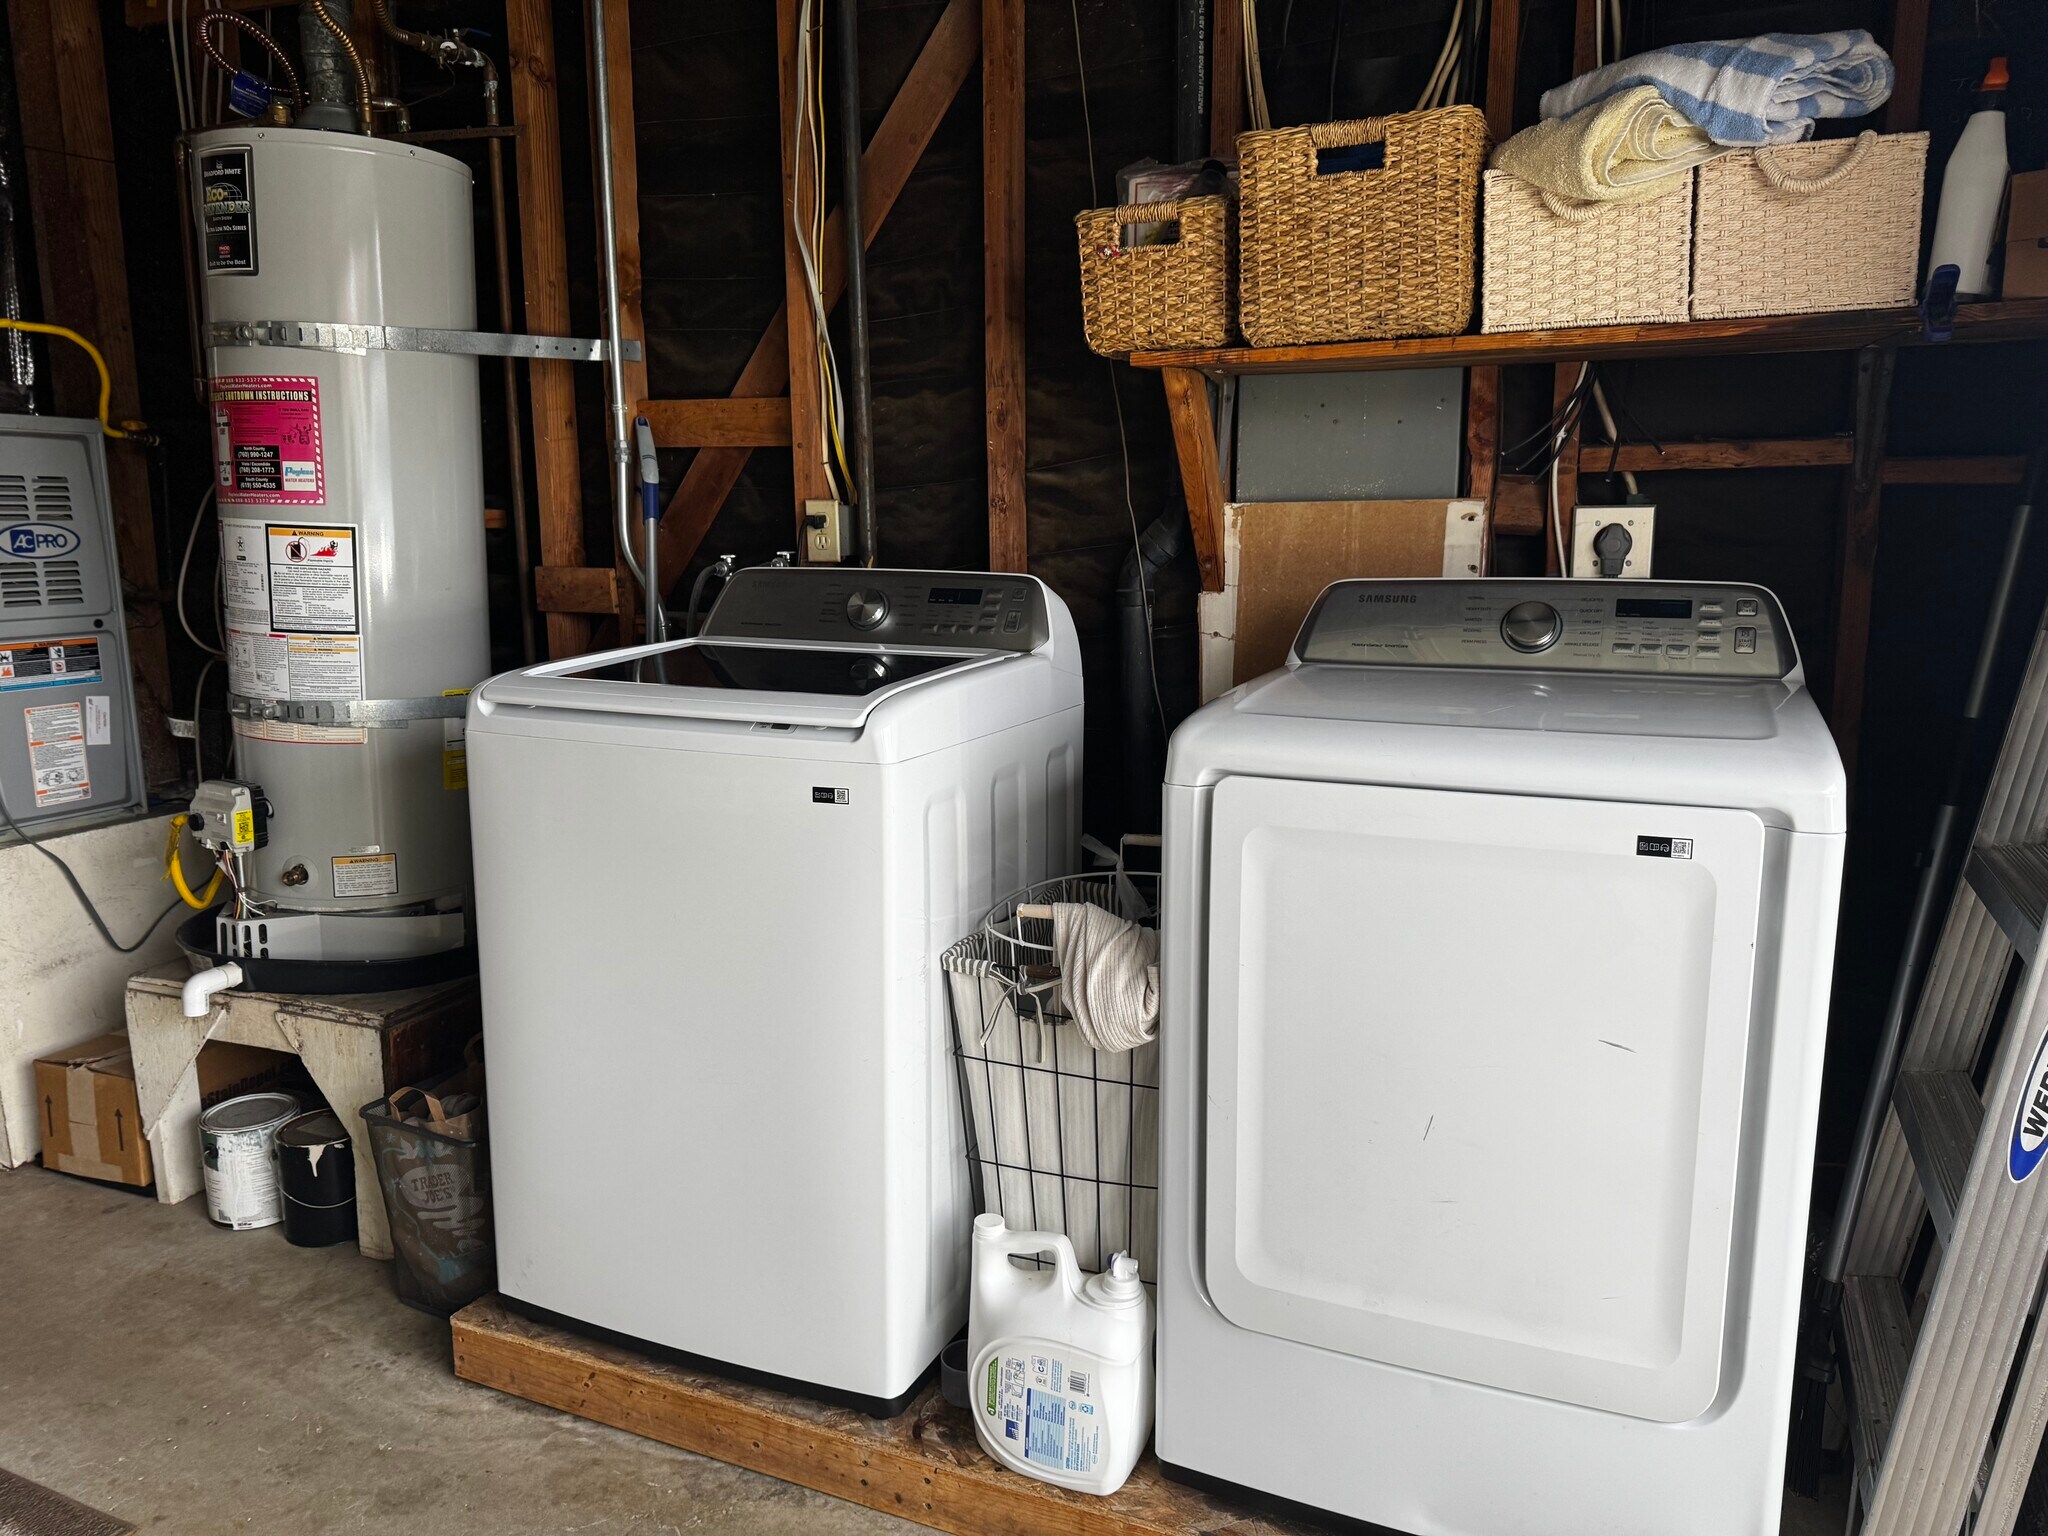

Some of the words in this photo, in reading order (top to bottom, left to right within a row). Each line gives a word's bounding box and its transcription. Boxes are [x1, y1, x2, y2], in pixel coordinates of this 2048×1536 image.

[255, 390, 309, 401] INSTRUCTIONS
[36, 534, 68, 548] PRO
[1358, 594, 1417, 603] SAMSUNG
[411, 1172, 454, 1192] TRADER
[424, 1188, 452, 1204] JOE'S
